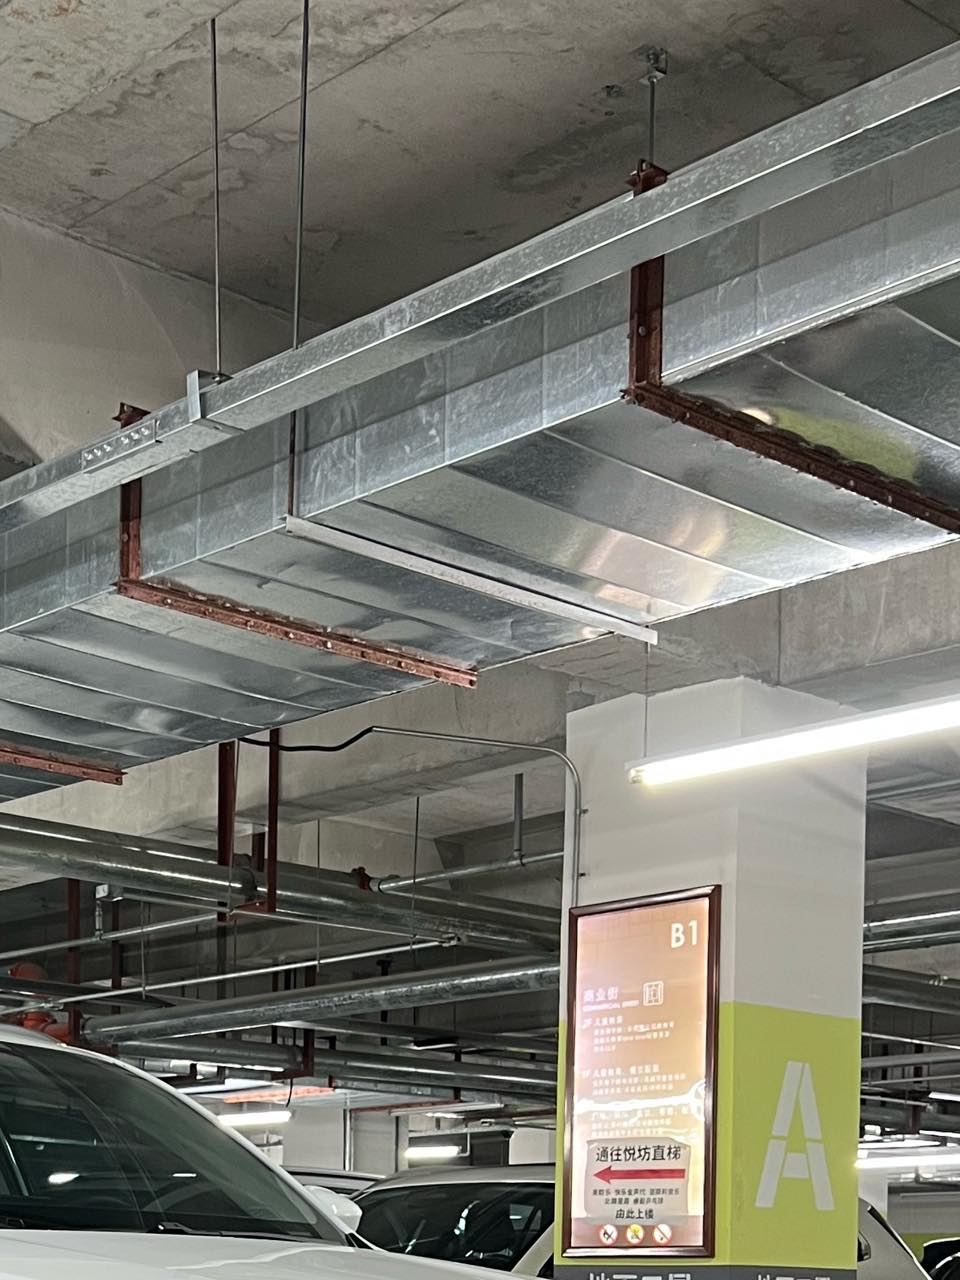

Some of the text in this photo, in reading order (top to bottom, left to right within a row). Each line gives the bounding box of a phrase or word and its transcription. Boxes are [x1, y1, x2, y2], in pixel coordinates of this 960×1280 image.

[670, 919, 699, 949] B1
[754, 1060, 835, 1212] A
[596, 1144, 681, 1162] 通往悦坊直梯
